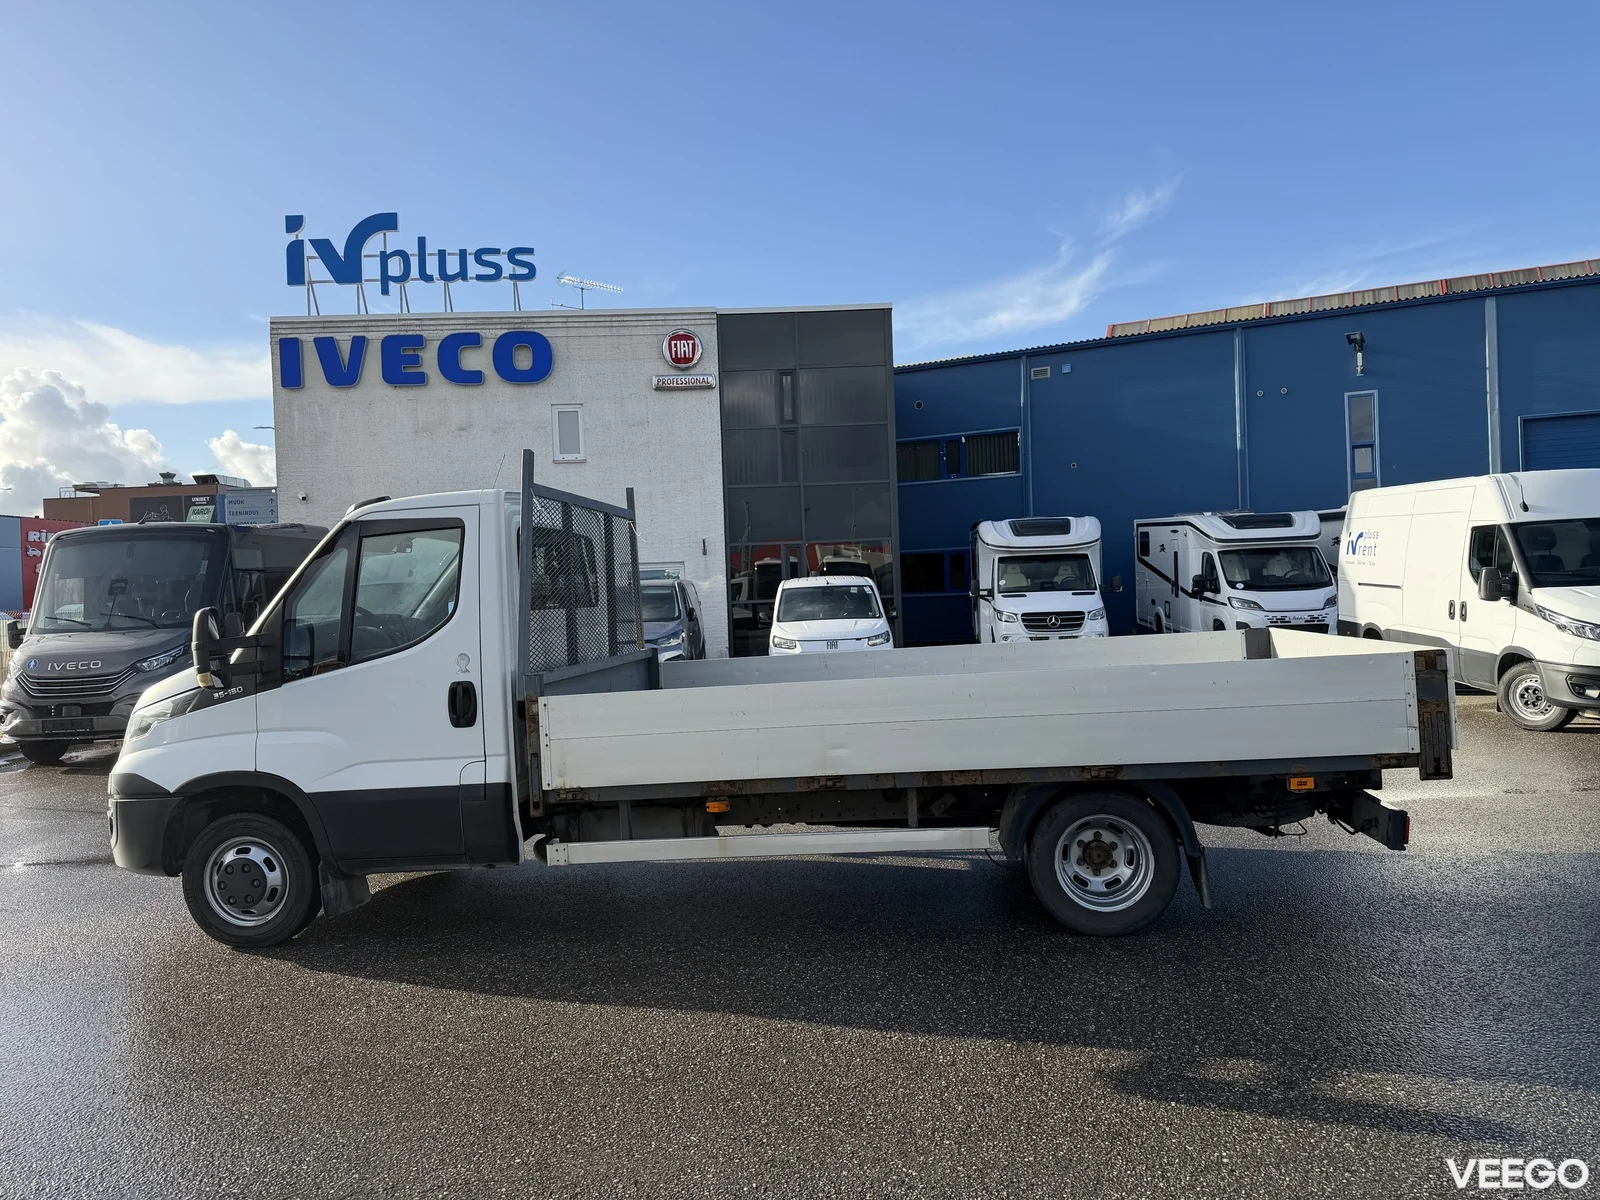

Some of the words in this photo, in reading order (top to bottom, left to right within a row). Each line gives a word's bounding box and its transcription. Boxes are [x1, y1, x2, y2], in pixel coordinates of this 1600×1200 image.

[671, 340, 694, 358] FIAT
[278, 330, 554, 388] IVECO
[656, 377, 710, 386] PROFESSIONAL
[1357, 543, 1377, 556] rent
[827, 641, 838, 649] FIAT
[47, 660, 102, 671] IVECO
[213, 686, 243, 700] 35-150
